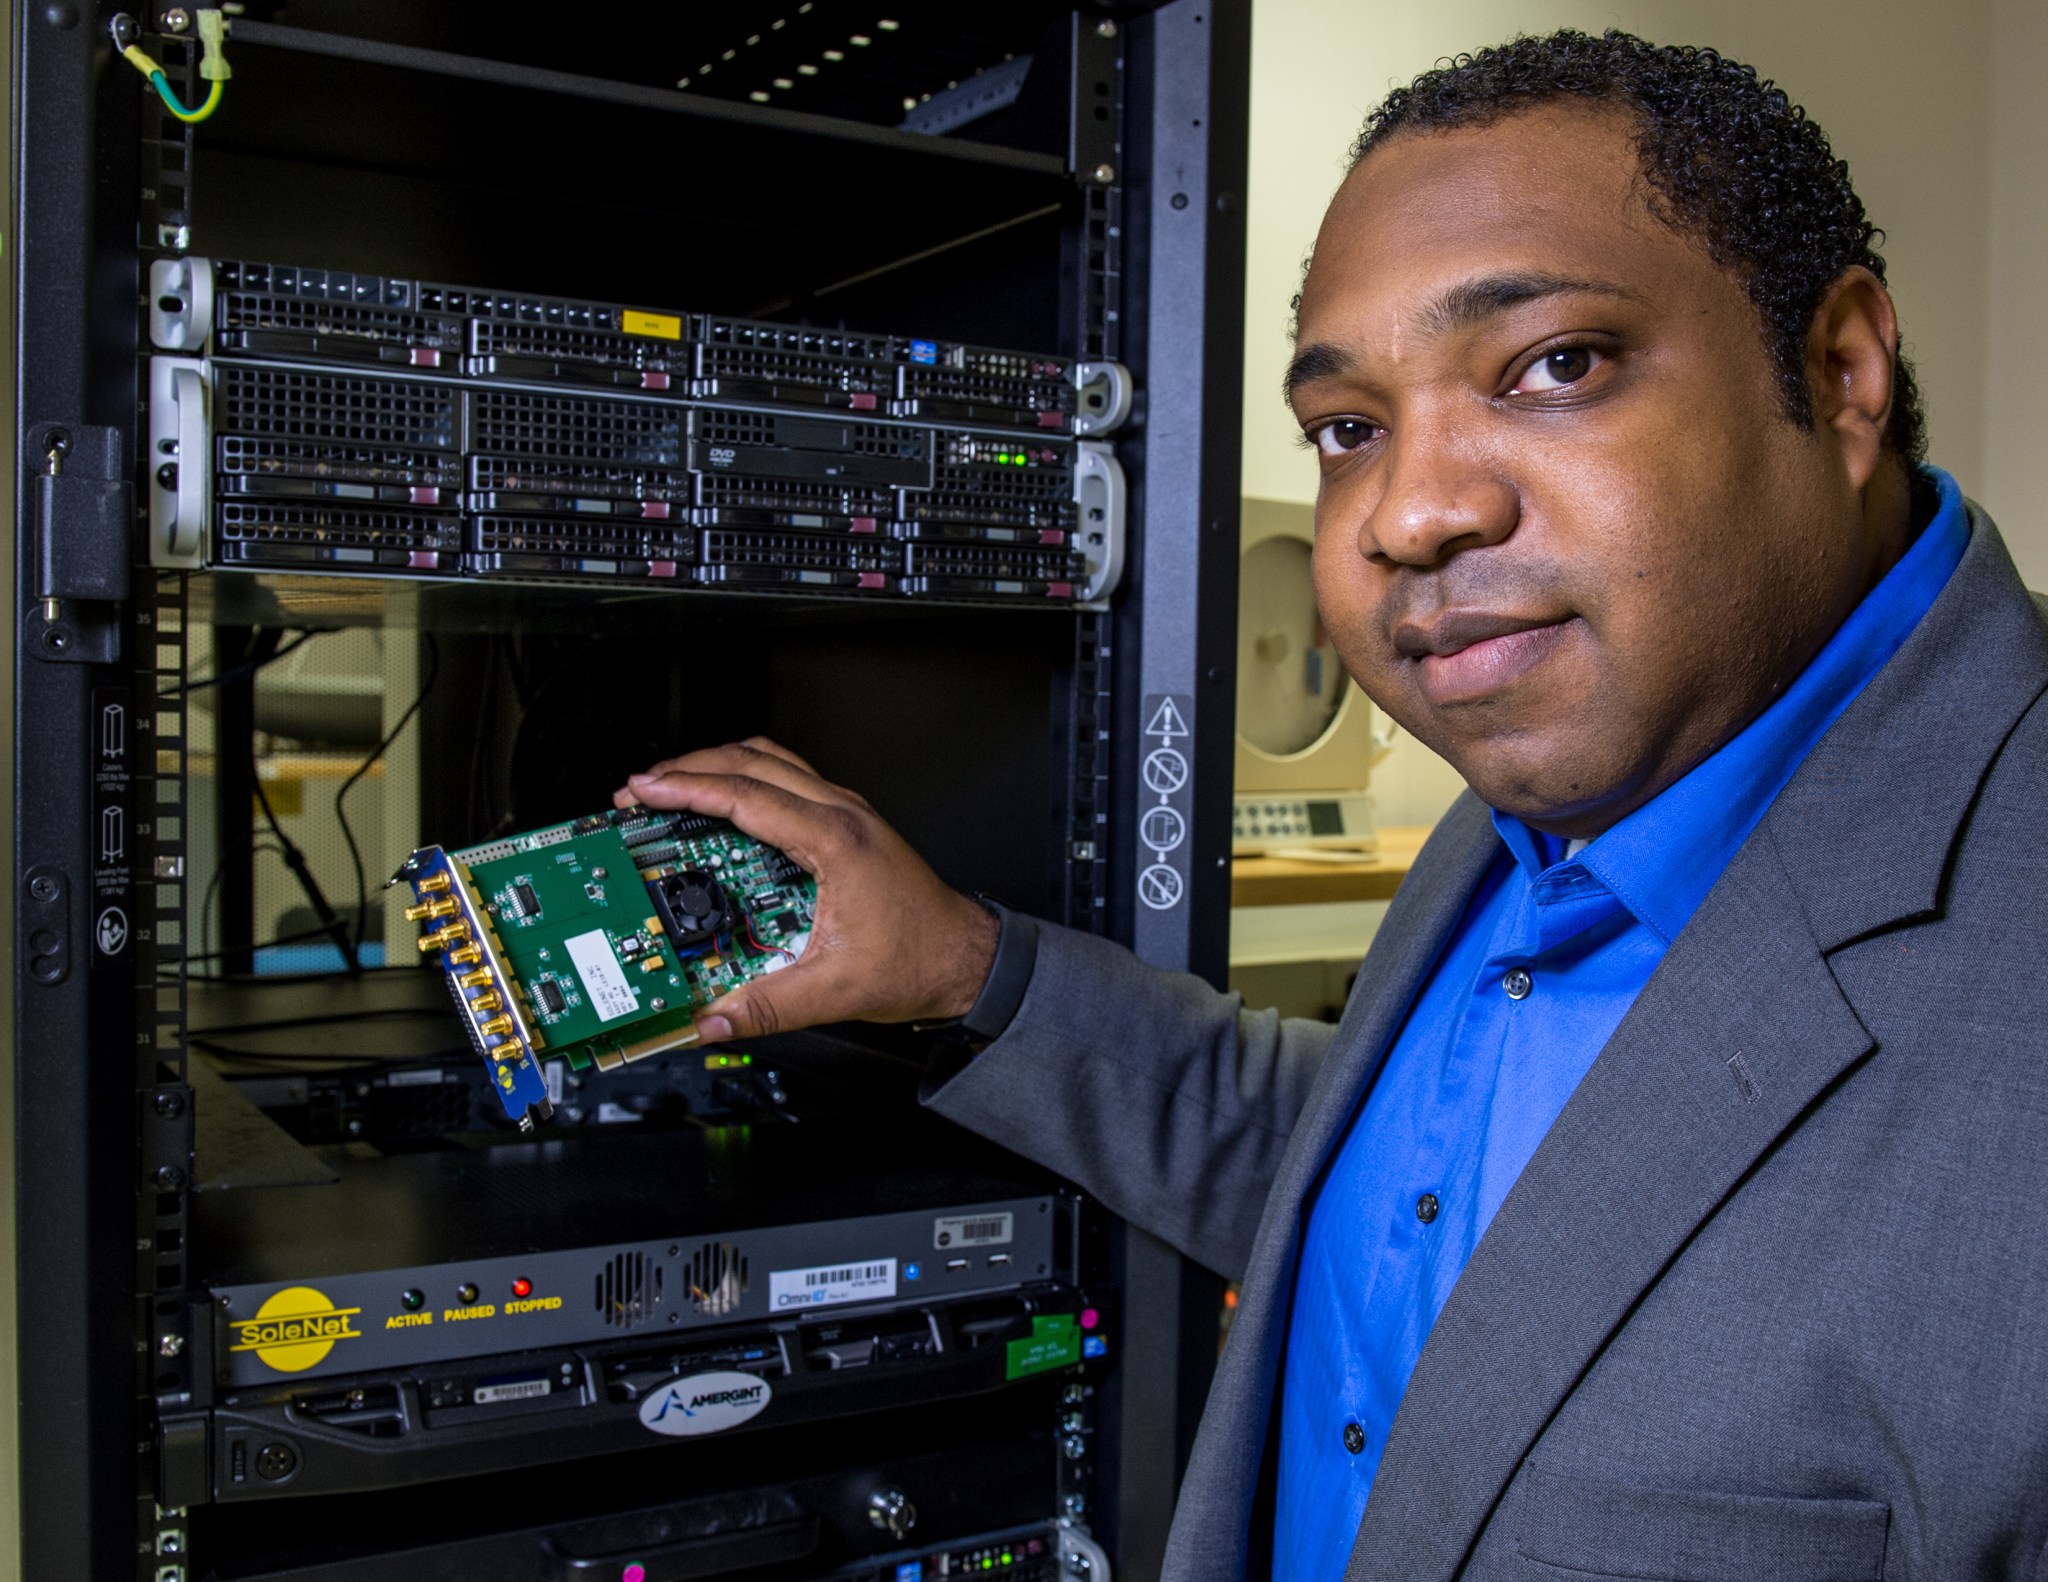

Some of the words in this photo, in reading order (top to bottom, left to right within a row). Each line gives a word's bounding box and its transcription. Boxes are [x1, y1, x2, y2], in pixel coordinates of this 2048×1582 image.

[710, 448, 736, 458] DVD
[136, 613, 151, 625] 35
[136, 718, 150, 730] 34
[136, 823, 151, 835] 33
[136, 928, 151, 940] 32
[586, 965, 597, 980] INC
[595, 986, 615, 1017] SOLENET
[136, 1033, 150, 1044] 31
[504, 1296, 562, 1315] STOPPED
[386, 1312, 432, 1329] ACTIVE
[444, 1305, 495, 1322] PAUSED
[241, 1315, 350, 1345] SoleNet
[690, 1385, 762, 1408] AMERGINT
